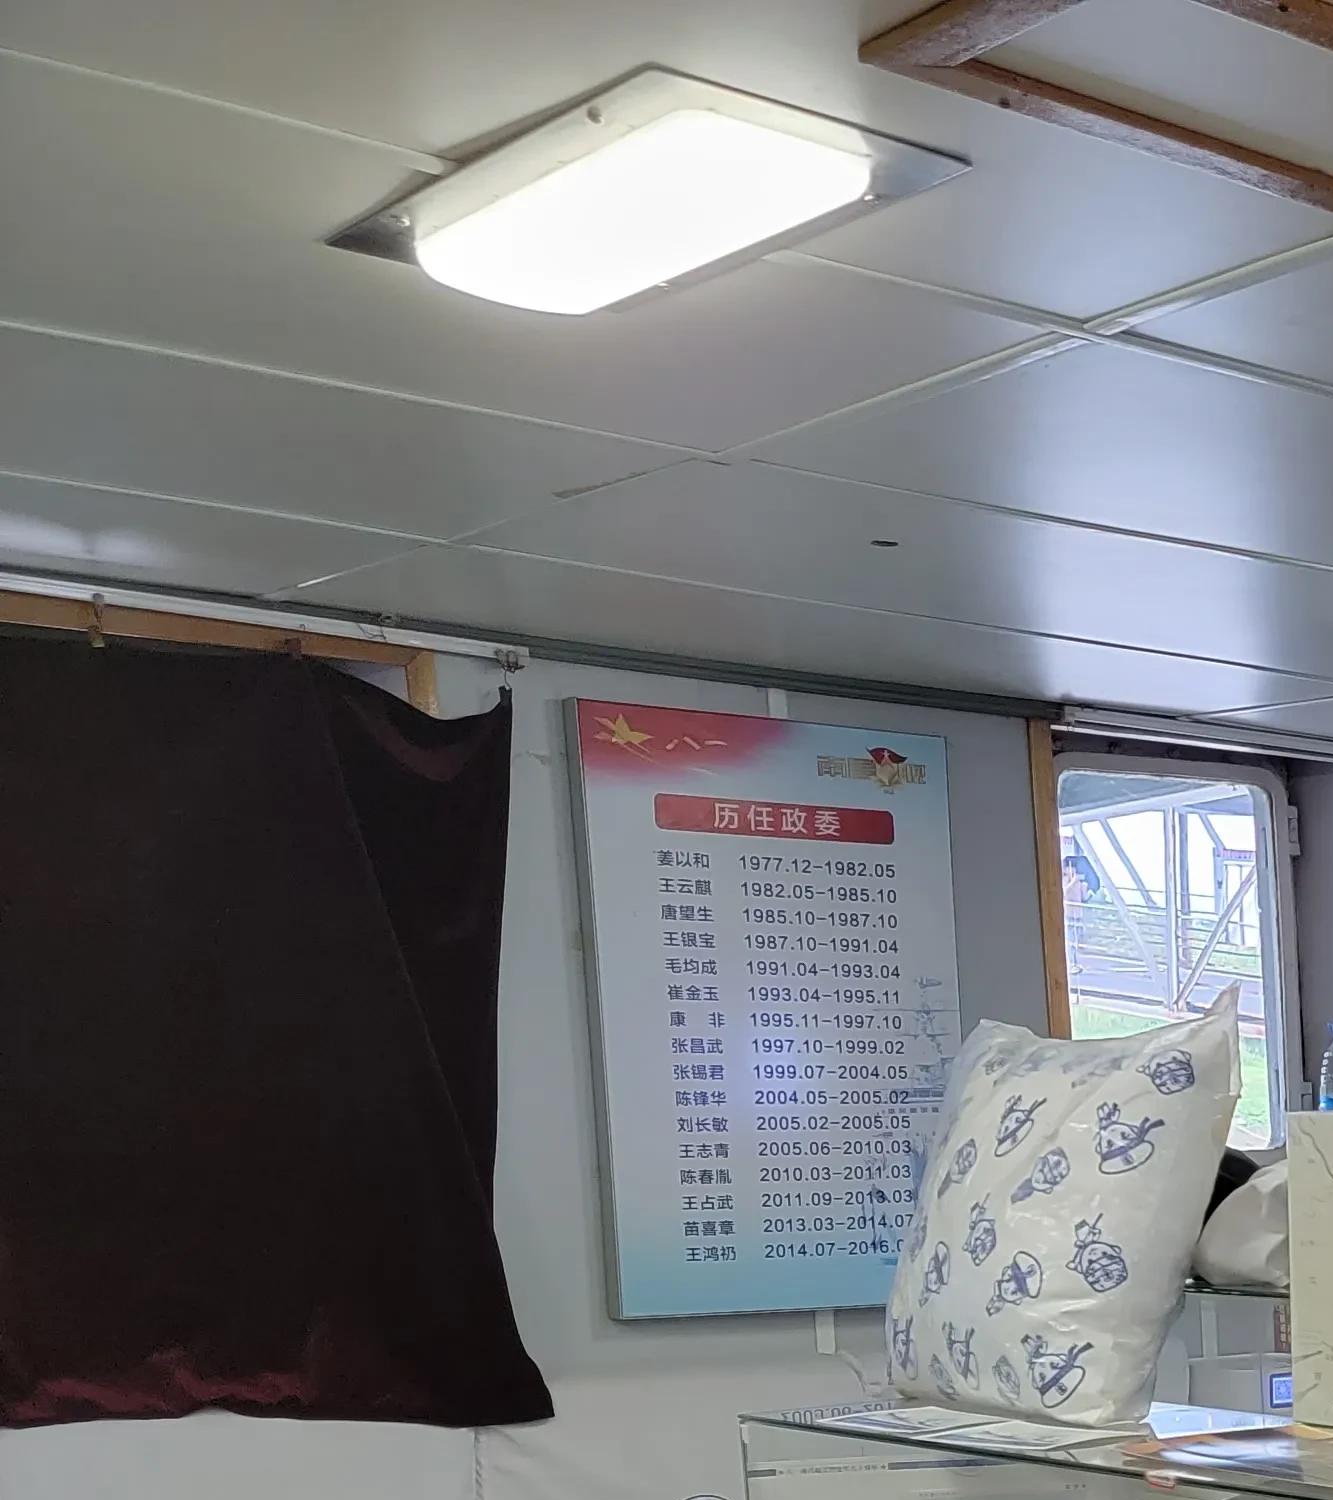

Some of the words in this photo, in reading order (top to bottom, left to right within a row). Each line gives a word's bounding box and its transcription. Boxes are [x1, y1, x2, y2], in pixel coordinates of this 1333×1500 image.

[713, 801, 843, 838] 历任政委
[739, 855, 896, 879] 1977.12-1982.05
[740, 881, 898, 904] 1982.05-1985.10
[742, 908, 898, 929] 1985.10-1987.10
[744, 934, 899, 954] 1987.10-1991.04
[746, 960, 900, 980] 1991.04-1993.04
[747, 986, 901, 1005] 1993.04-1995.11
[750, 1012, 902, 1030] 1995.11-1997.10
[751, 1039, 905, 1055] 1997.10-1999.02
[753, 1065, 908, 1080] 1999.07-2004.05
[754, 1090, 909, 1105] 2004.05-2005.02
[756, 1115, 911, 1131] 2005.02-2005.05
[758, 1140, 912, 1156] 2005.06-2010.03
[759, 1165, 912, 1182] 2010.03-2011.03
[761, 1189, 913, 1207] 2011.09-2013.03
[763, 1214, 914, 1233] 2013.03-2014.07
[764, 1239, 904, 1259] 2014.07-2016.0
